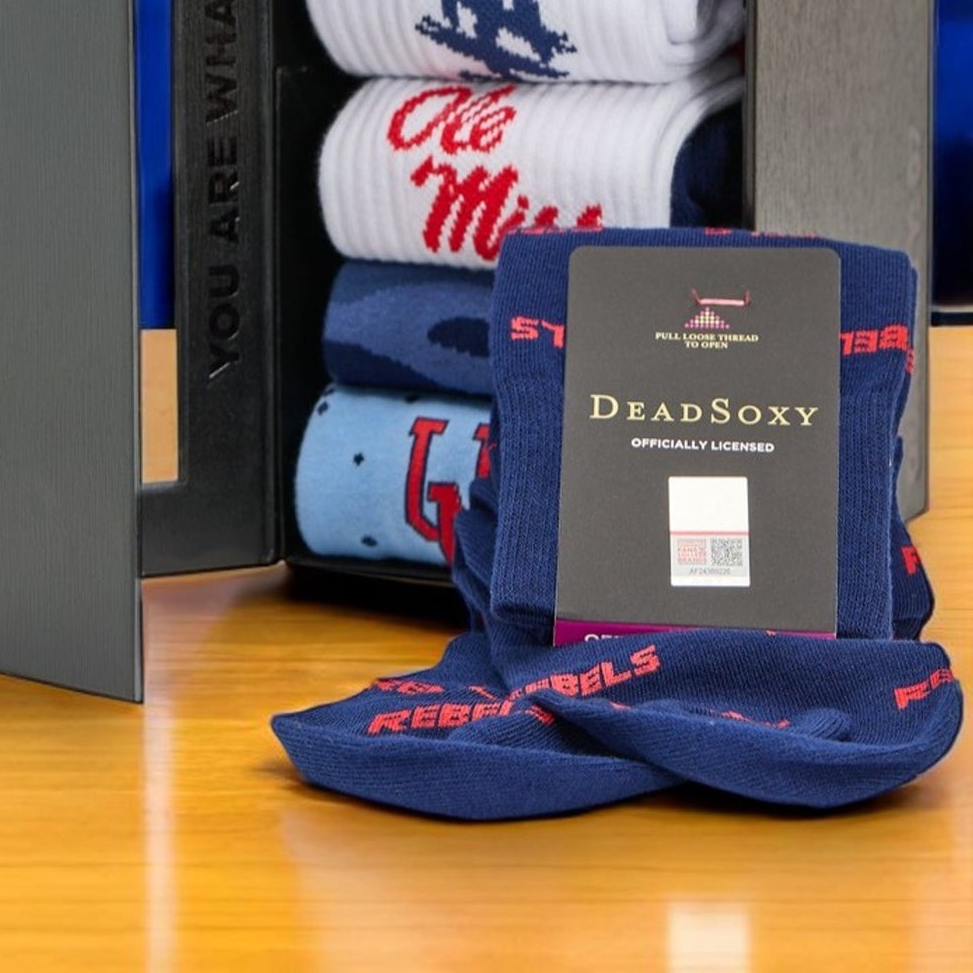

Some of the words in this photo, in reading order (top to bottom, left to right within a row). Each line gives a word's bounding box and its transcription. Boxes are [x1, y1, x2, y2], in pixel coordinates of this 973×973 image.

[387, 83, 518, 155] Ole
[207, 136, 240, 244] ARE
[208, 265, 240, 379] YOU
[655, 331, 681, 340] PULL
[682, 332, 716, 341] LOOSE
[718, 333, 759, 342] THREAD
[700, 341, 729, 349] OPEN
[589, 393, 819, 426] DEADSOXY
[631, 437, 707, 451] OFFICIALLY
[711, 439, 775, 453] LICENSED
